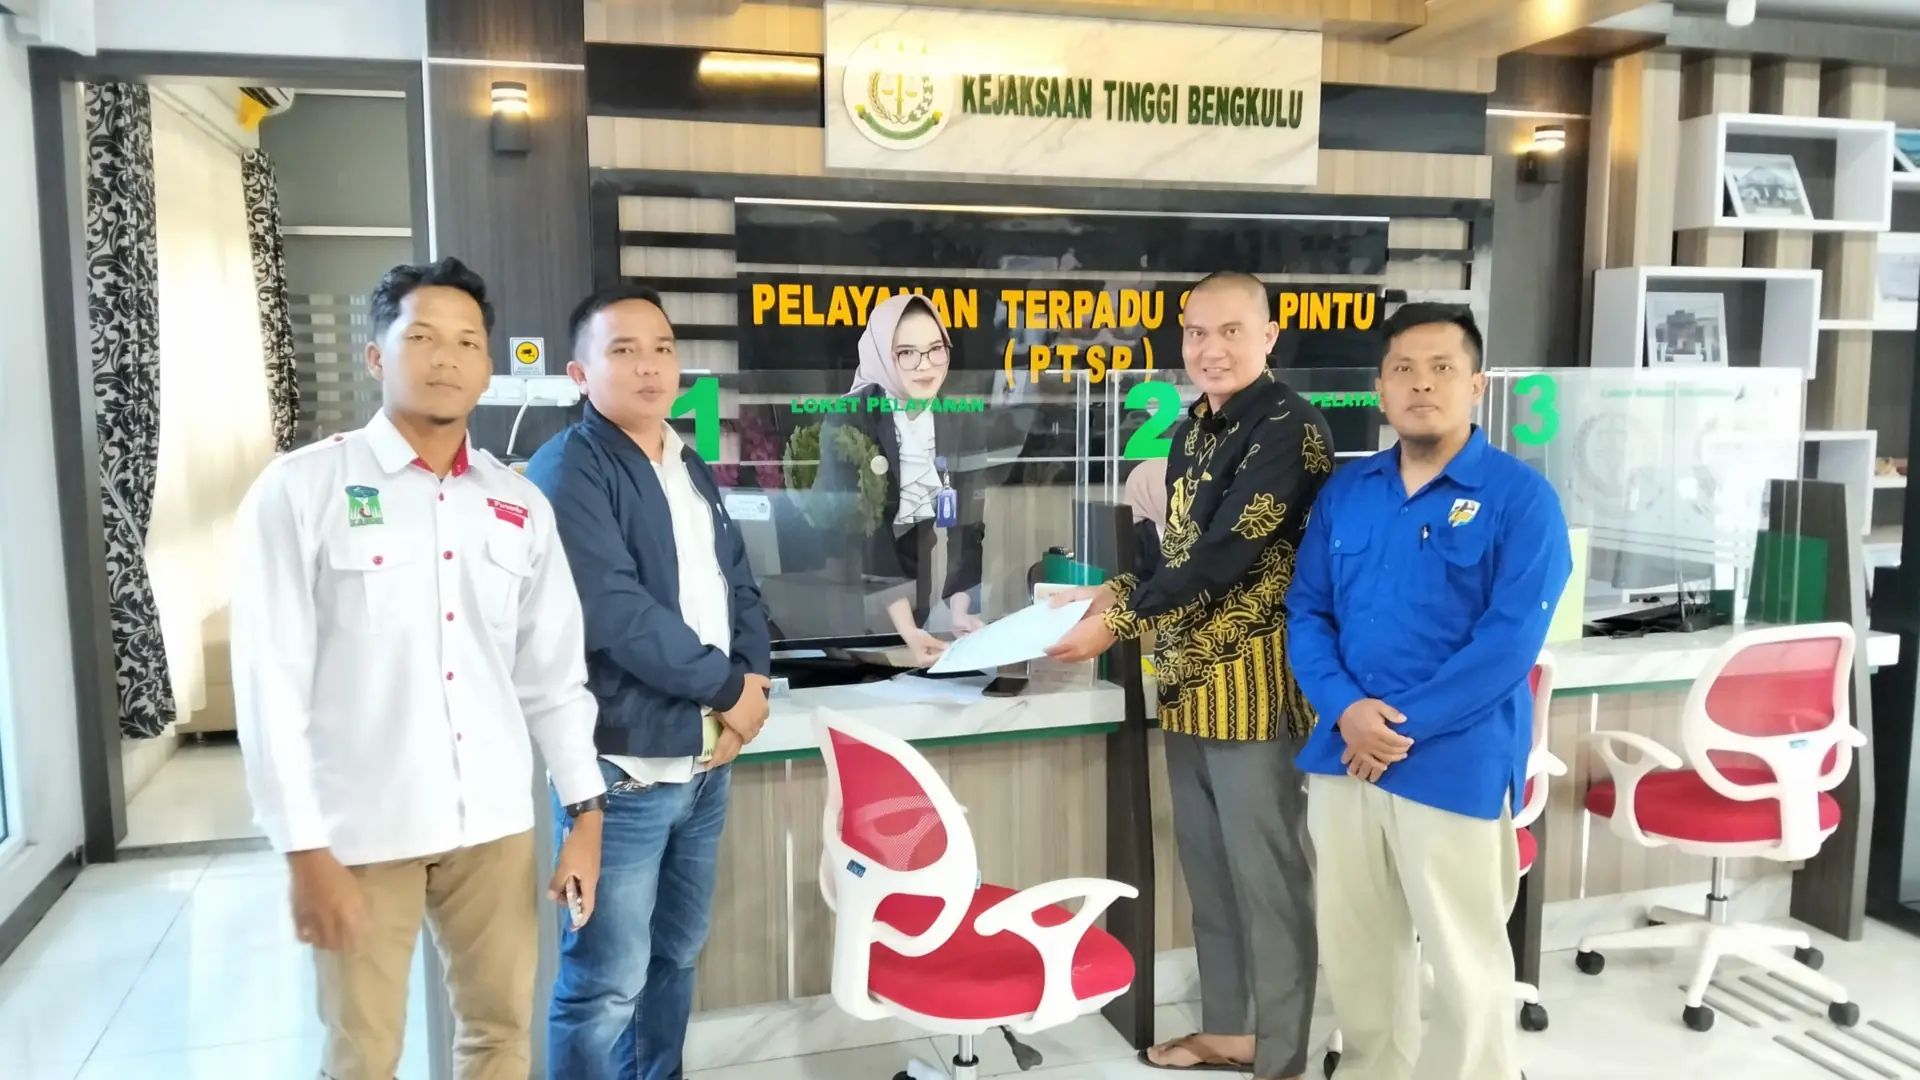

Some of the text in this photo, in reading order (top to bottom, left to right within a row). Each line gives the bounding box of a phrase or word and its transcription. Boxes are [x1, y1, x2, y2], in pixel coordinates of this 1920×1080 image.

[962, 73, 1303, 129] KEJAKSAAN TINGGI BENGKULU
[752, 284, 978, 328] PELAYAN
[1001, 289, 1164, 329] TERPADU
[1279, 292, 1376, 330] PINTU
[670, 376, 720, 462] 1
[791, 396, 984, 413] LOKET PELAYANAN
[1123, 380, 1181, 459] 2
[1512, 373, 1560, 446] 3
